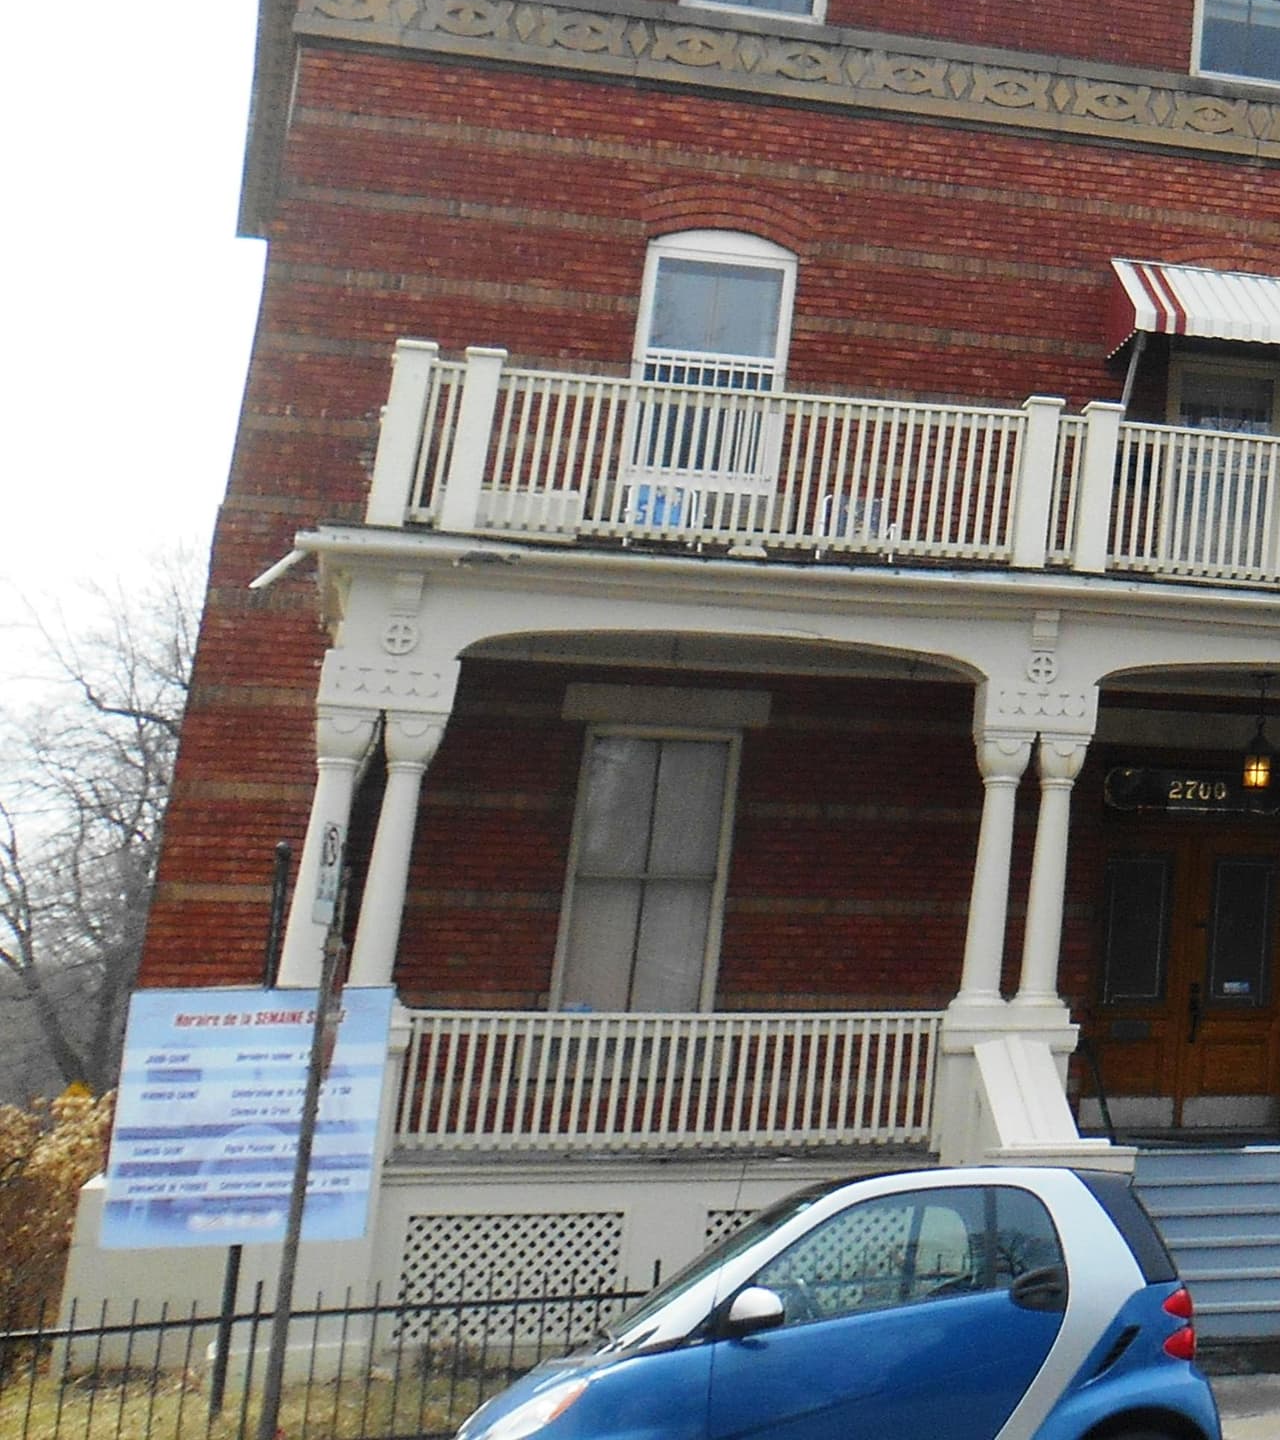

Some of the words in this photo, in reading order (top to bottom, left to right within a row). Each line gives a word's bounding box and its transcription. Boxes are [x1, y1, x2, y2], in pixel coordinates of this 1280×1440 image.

[1168, 780, 1227, 800] 2700
[223, 1012, 237, 1026] de
[255, 1010, 304, 1025] SEMAINE
